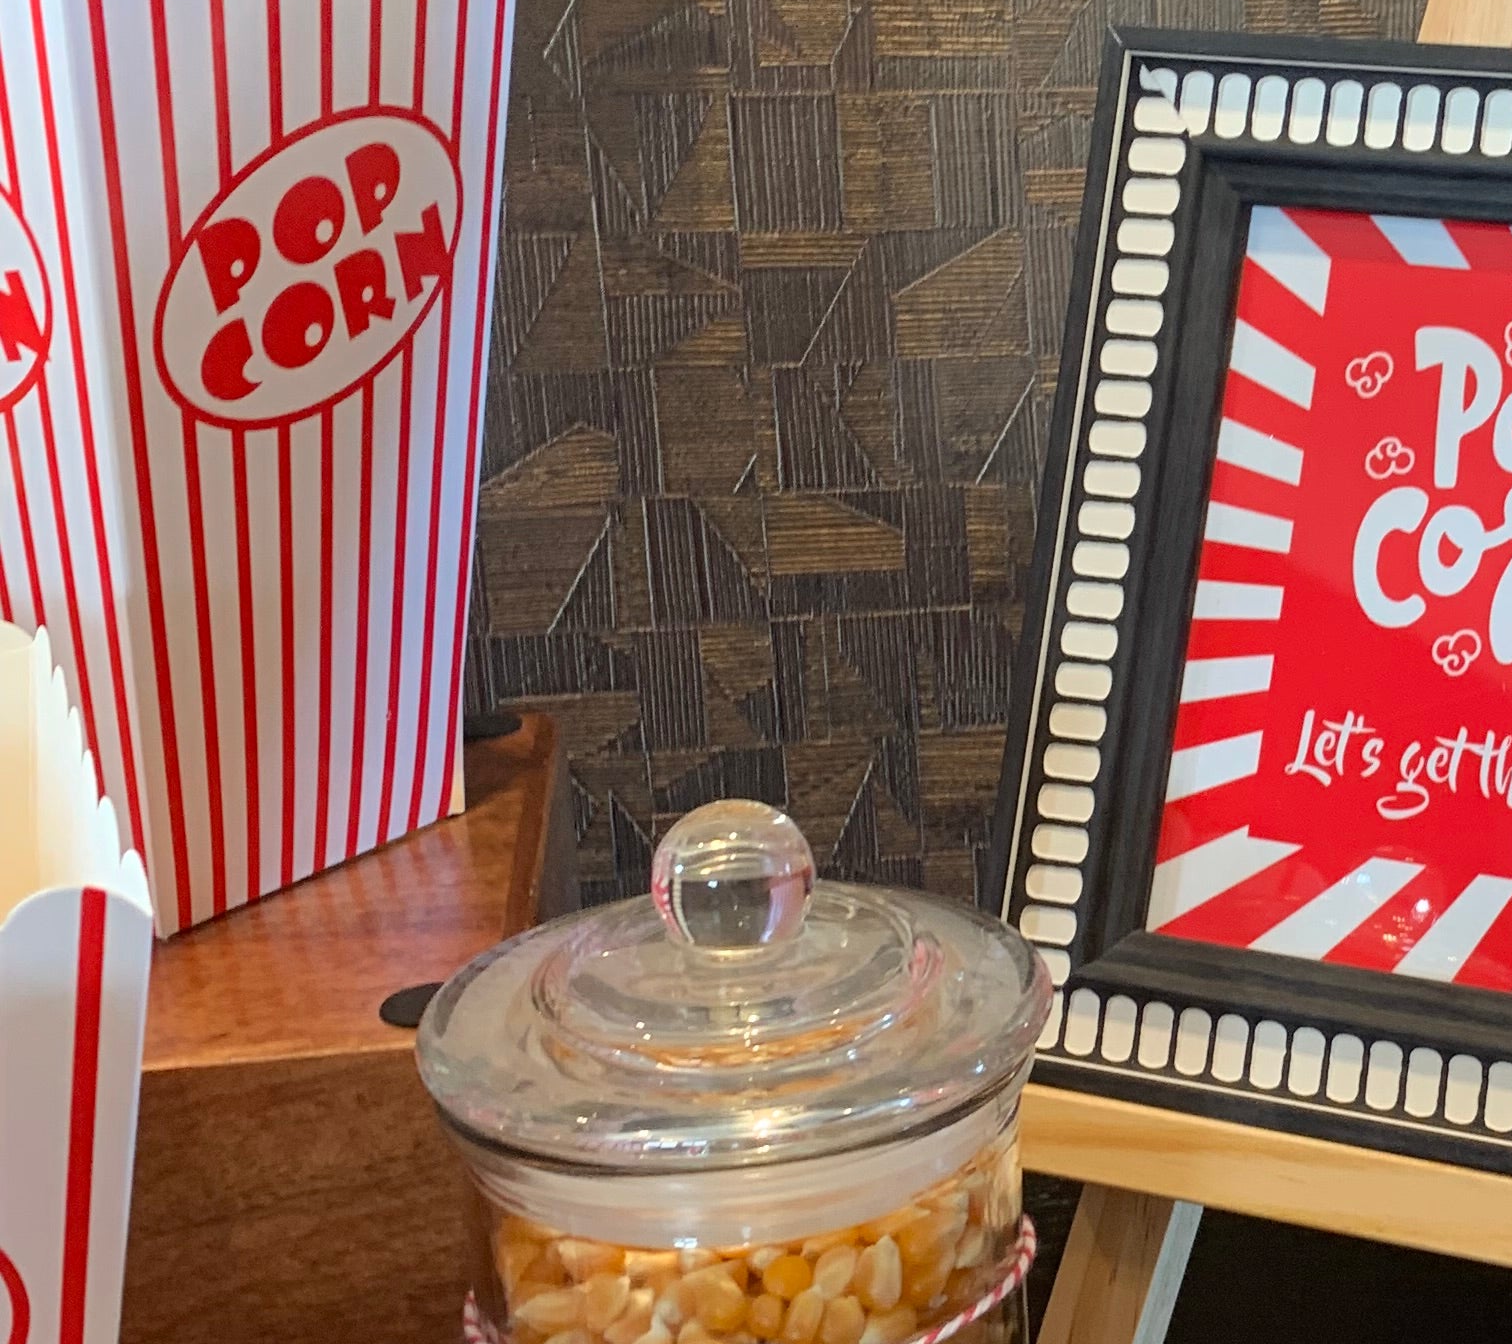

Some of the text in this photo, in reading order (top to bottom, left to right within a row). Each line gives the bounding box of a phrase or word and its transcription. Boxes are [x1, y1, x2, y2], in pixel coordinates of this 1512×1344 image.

[197, 141, 402, 315] POP
[201, 203, 450, 401] CORN
[1284, 709, 1383, 787] Let's
[1376, 726, 1475, 821] get
